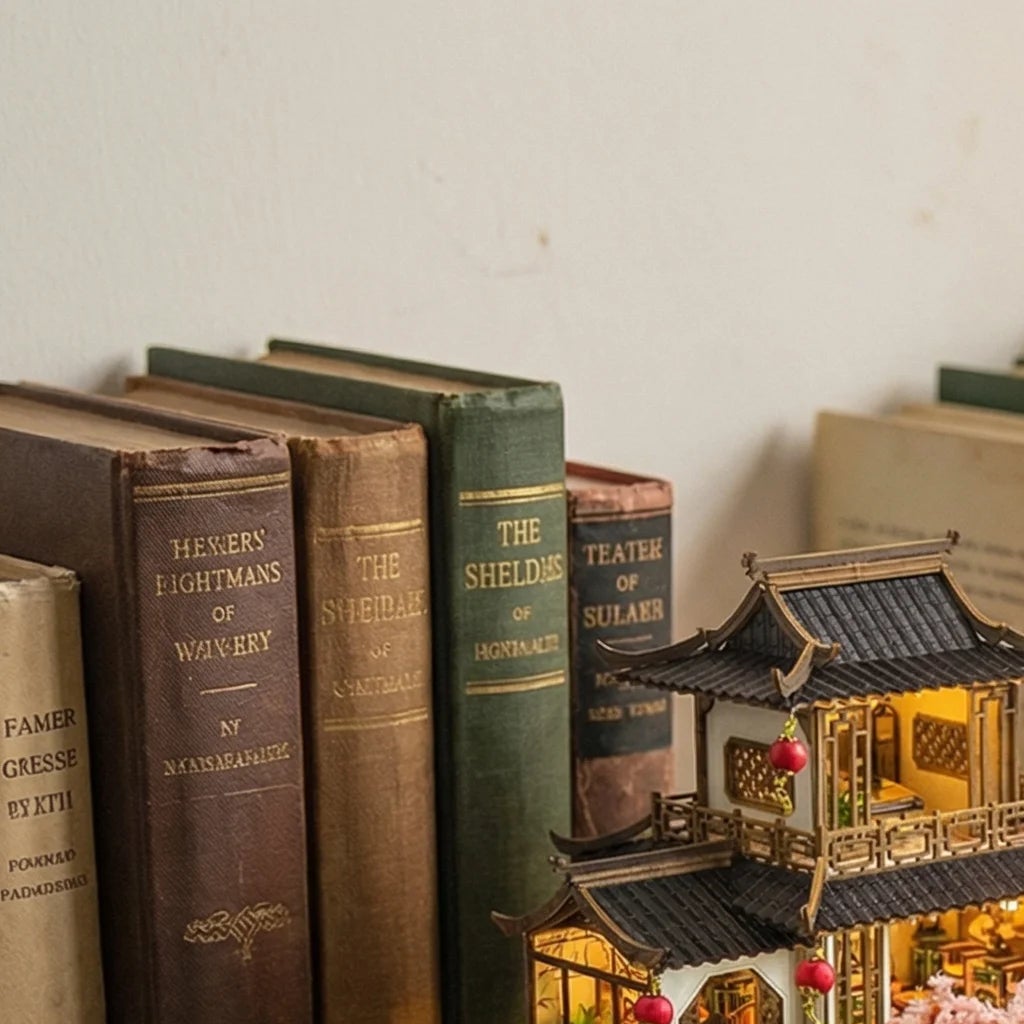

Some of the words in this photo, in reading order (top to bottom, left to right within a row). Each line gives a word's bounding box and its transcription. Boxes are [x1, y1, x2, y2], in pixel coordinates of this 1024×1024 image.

[497, 517, 541, 548] THE
[356, 551, 401, 582] THE
[616, 573, 640, 593] OF
[212, 604, 235, 623] OF
[512, 605, 533, 622] OF
[3, 708, 77, 739] FAMER
[2, 748, 79, 779] GRESSE
